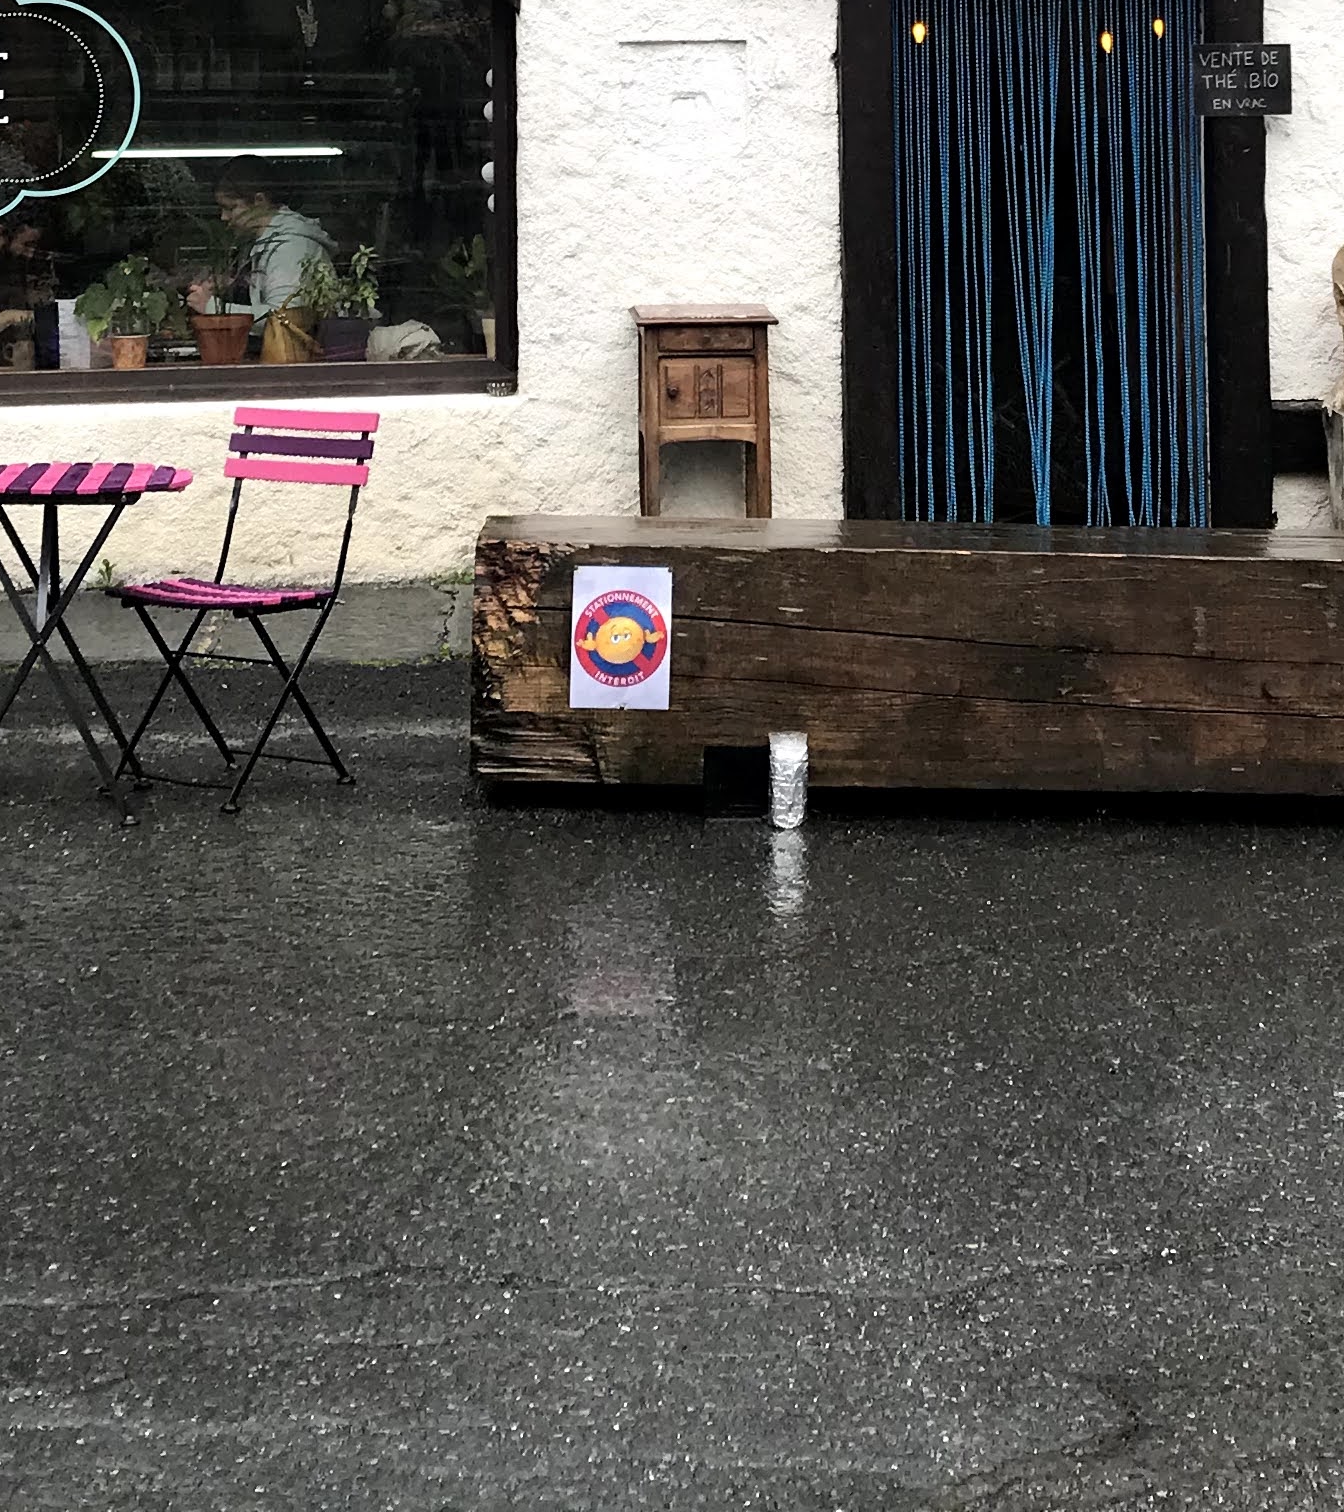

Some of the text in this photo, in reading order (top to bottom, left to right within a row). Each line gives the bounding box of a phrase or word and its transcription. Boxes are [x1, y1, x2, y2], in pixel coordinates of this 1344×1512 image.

[1199, 51, 1279, 68] VENTE DE
[1201, 68, 1237, 89] THÉ
[1212, 98, 1232, 110] EN
[584, 591, 660, 619] STATIONNEMENT
[594, 670, 646, 686] INTERDIT
